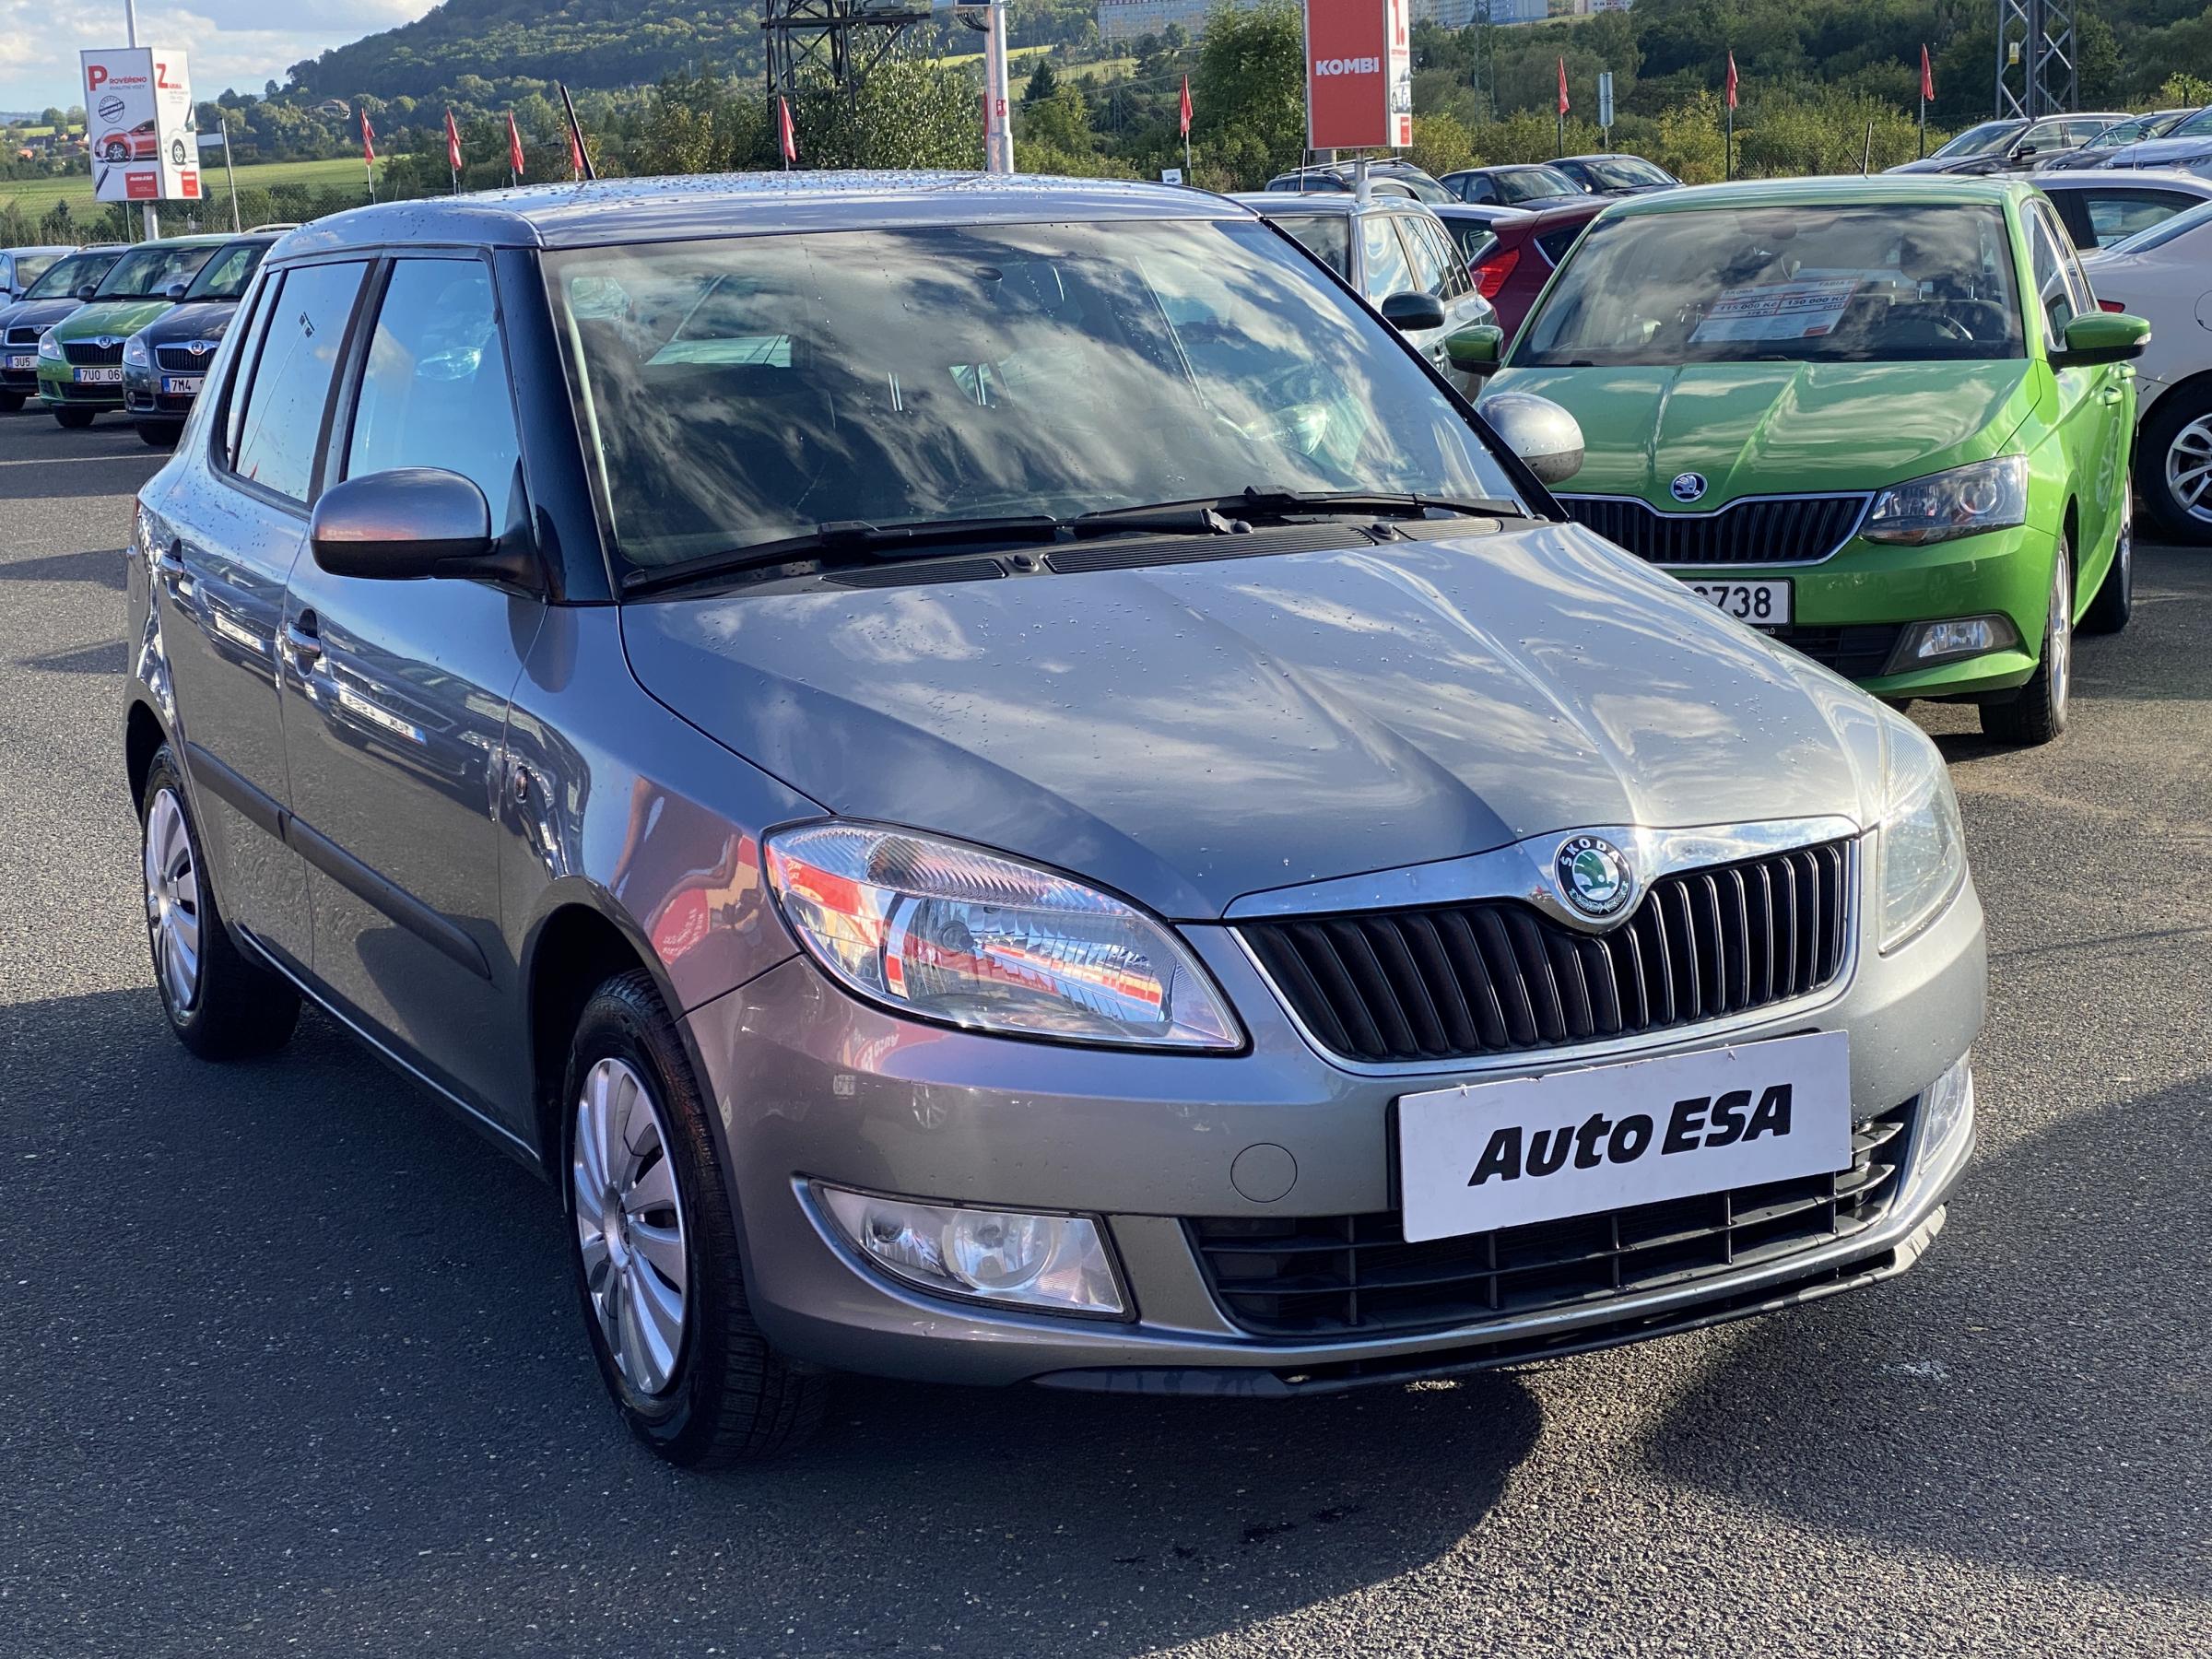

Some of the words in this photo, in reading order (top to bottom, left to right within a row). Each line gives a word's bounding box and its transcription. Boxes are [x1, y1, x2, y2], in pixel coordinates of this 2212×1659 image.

[1315, 57, 1380, 76] KOMBI
[14, 357, 30, 367] 3U5
[107, 369, 123, 381] 06
[171, 380, 192, 391] 7M4
[1559, 838, 1620, 867] ŠKODA
[1467, 1113, 1653, 1187] Auto
[1662, 1083, 1793, 1156] ESA
